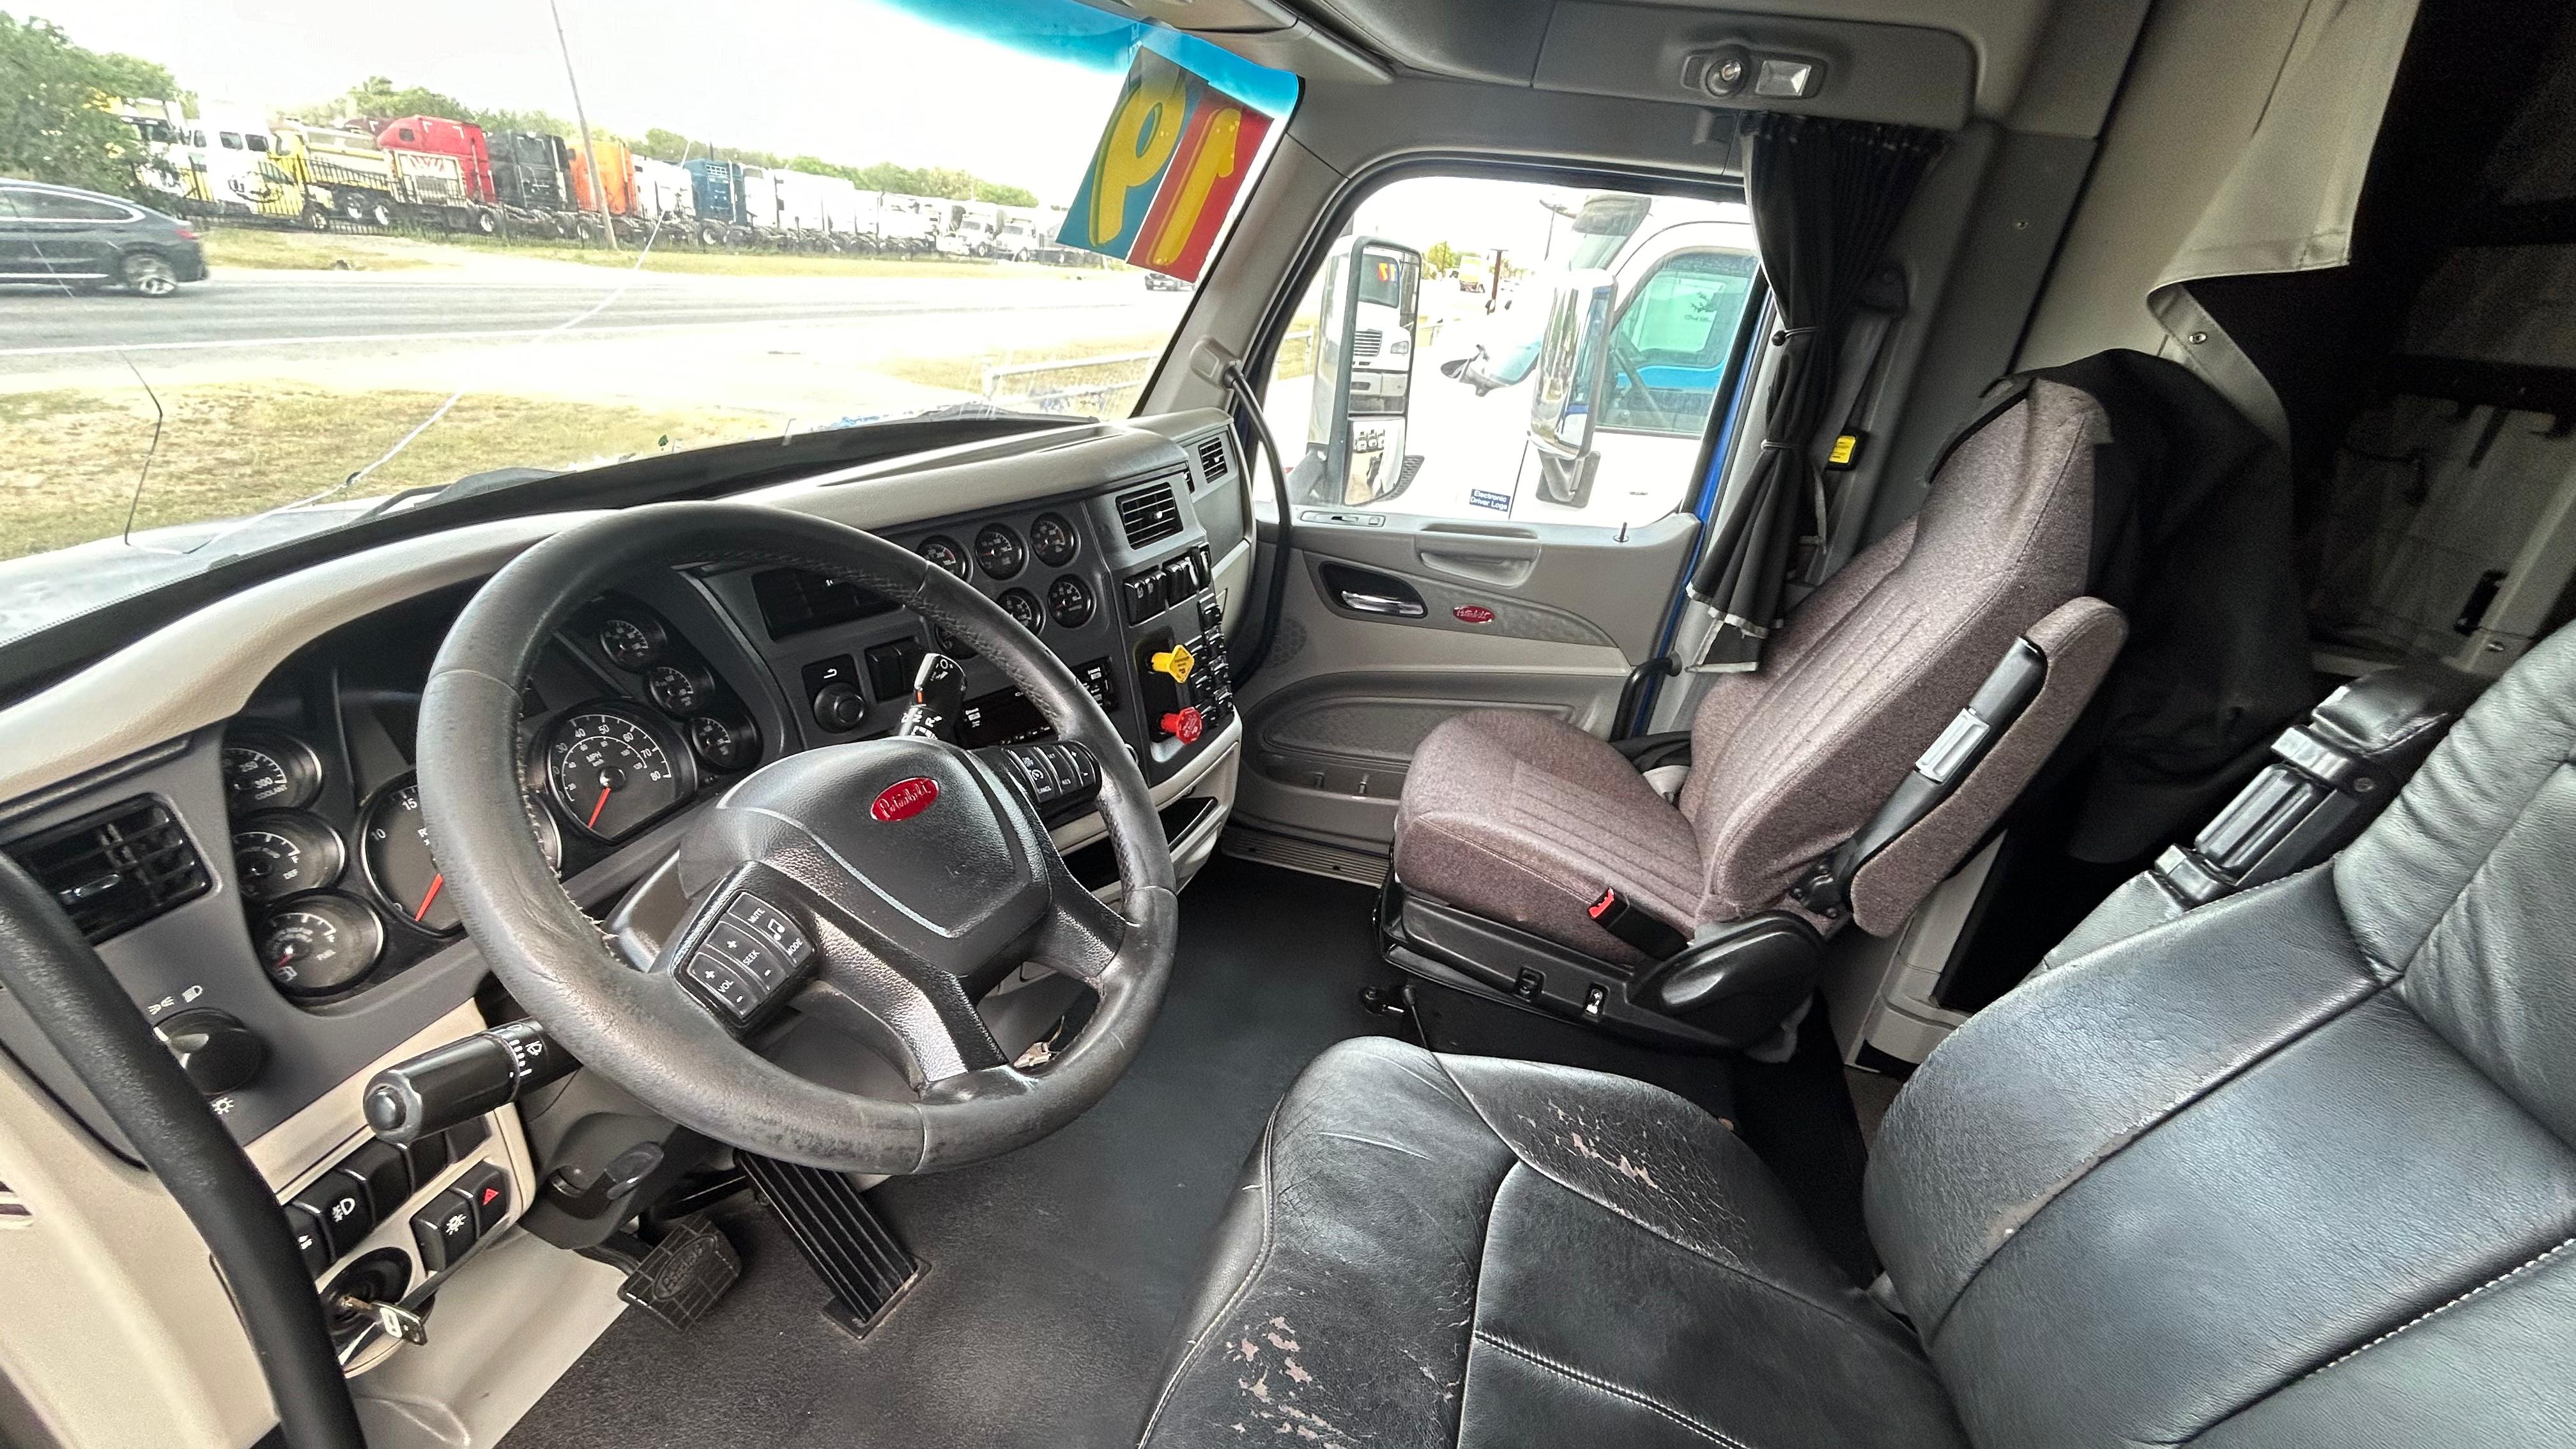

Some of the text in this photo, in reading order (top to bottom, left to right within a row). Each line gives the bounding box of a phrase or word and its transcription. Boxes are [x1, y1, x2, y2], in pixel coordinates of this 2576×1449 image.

[1473, 489, 1507, 503] Electronic
[1470, 496, 1508, 510] Driver Logs
[925, 717, 935, 728] R
[575, 728, 586, 738] 40
[598, 724, 610, 735] 50
[623, 732, 634, 742] 60
[556, 742, 568, 753] 30
[640, 748, 652, 758] 70
[586, 751, 602, 762] MPH
[650, 770, 661, 781] 80
[401, 797, 418, 811] 15
[371, 828, 387, 841] 10
[747, 907, 765, 924] MUTE
[786, 938, 803, 956] MODE
[742, 949, 760, 966] SEEK
[717, 979, 734, 993] VOL
